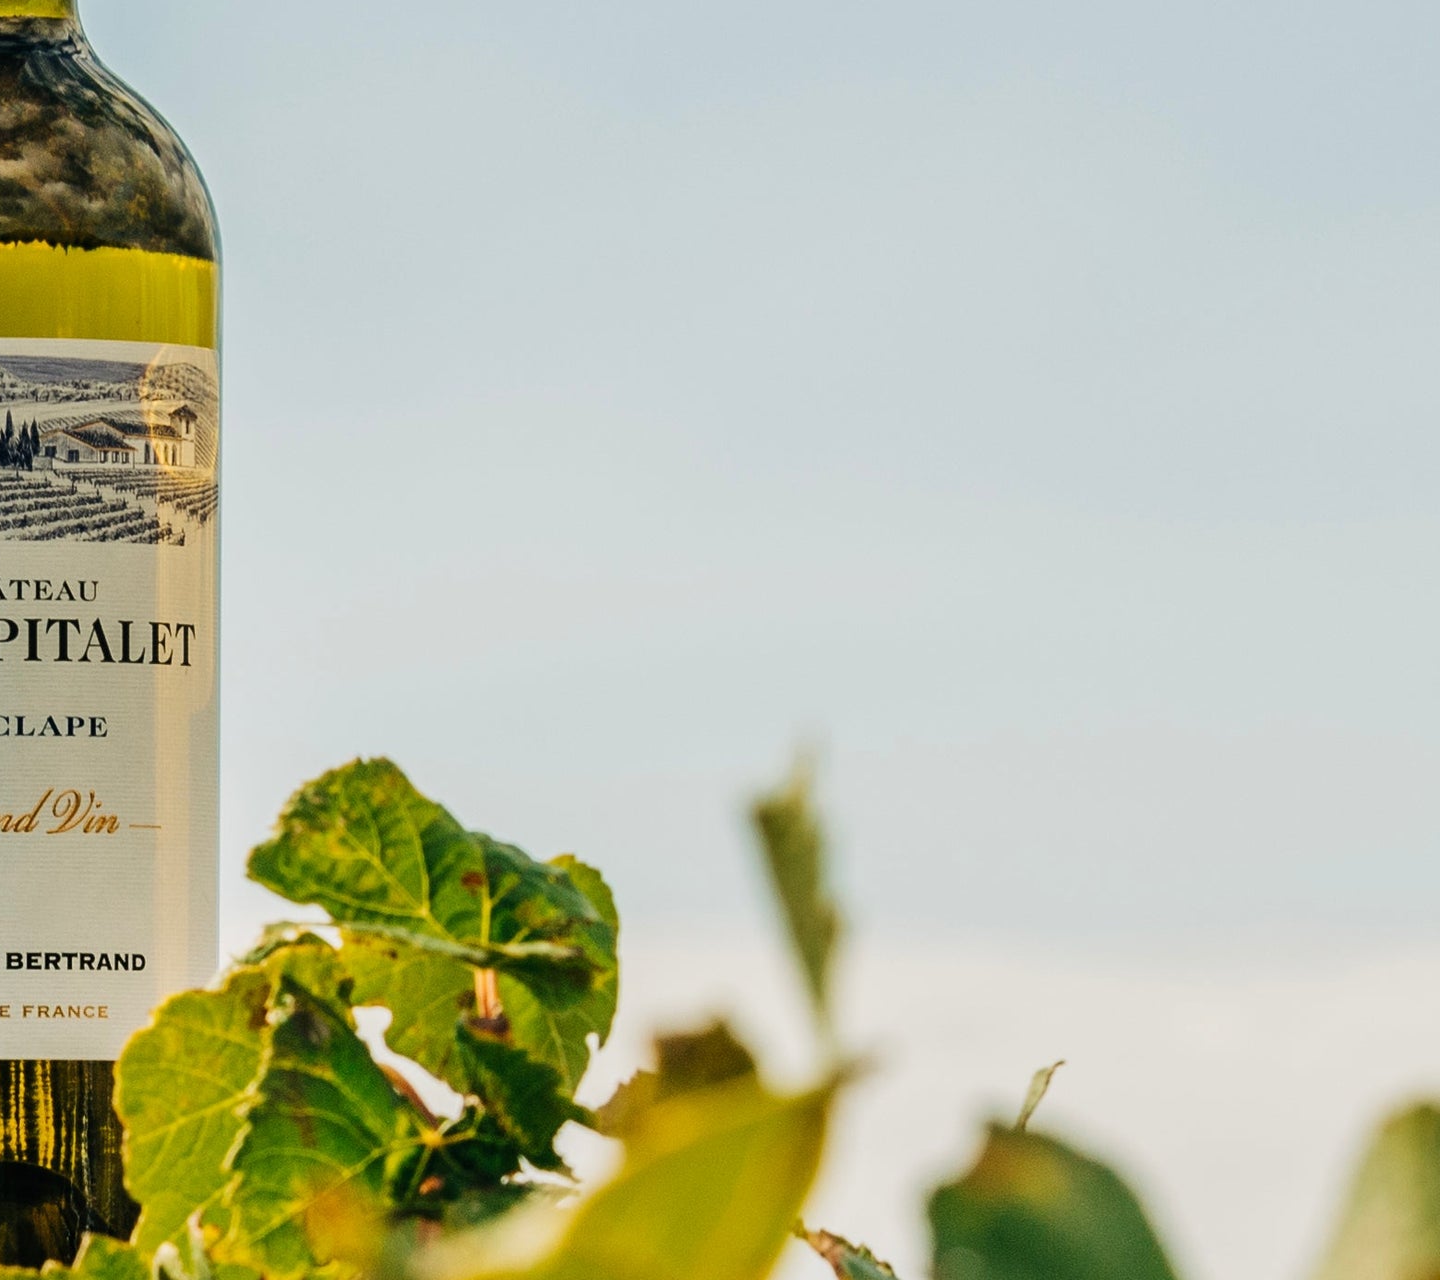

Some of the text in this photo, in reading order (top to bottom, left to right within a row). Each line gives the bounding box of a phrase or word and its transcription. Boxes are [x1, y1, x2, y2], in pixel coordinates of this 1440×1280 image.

[46, 788, 121, 835] Vin
[5, 952, 147, 972] BERTRAND
[22, 1004, 109, 1019] FRANCE
